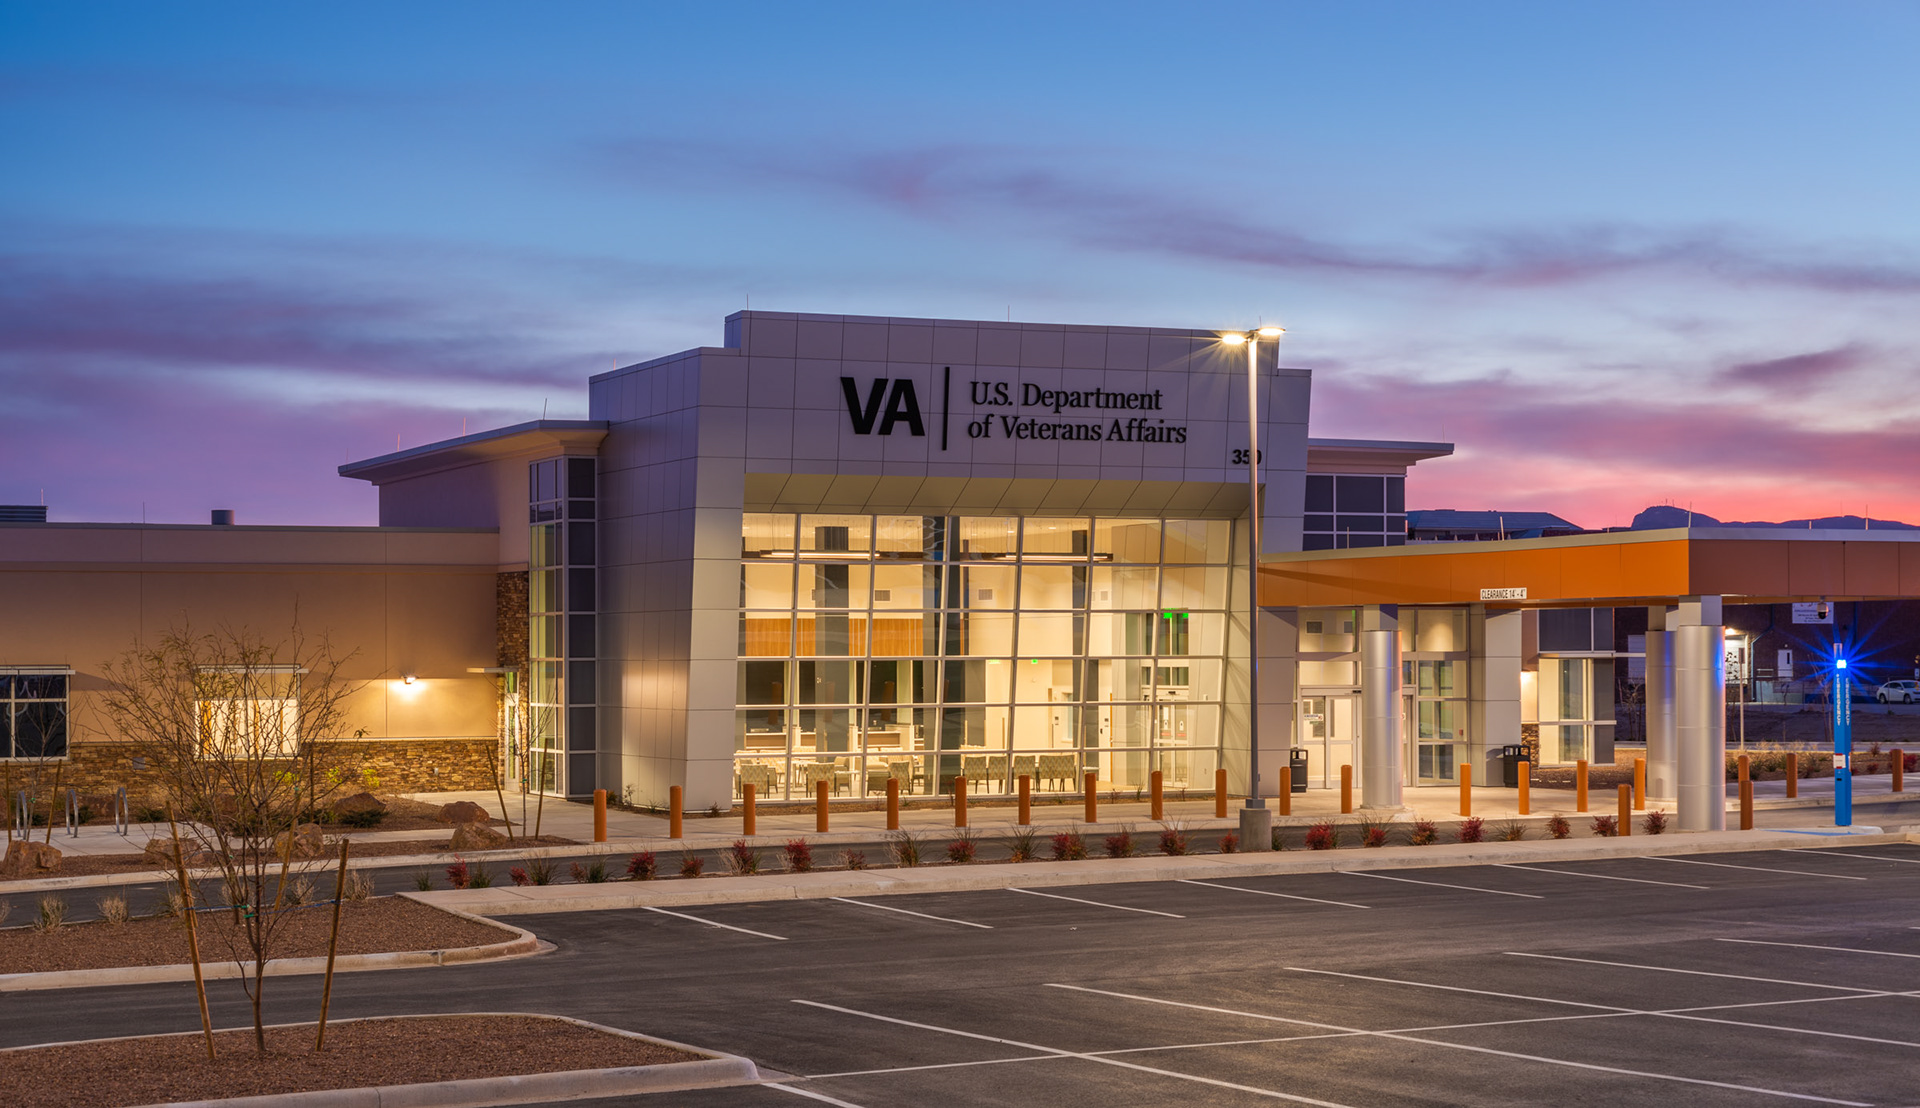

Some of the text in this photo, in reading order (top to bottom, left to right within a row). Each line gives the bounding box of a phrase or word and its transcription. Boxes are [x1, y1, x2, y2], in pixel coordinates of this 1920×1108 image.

[840, 376, 926, 437] VA
[969, 381, 1163, 414] U.S. Department
[967, 413, 1187, 444] of Veterans Affairs
[1482, 589, 1508, 599] CLEARANCE
